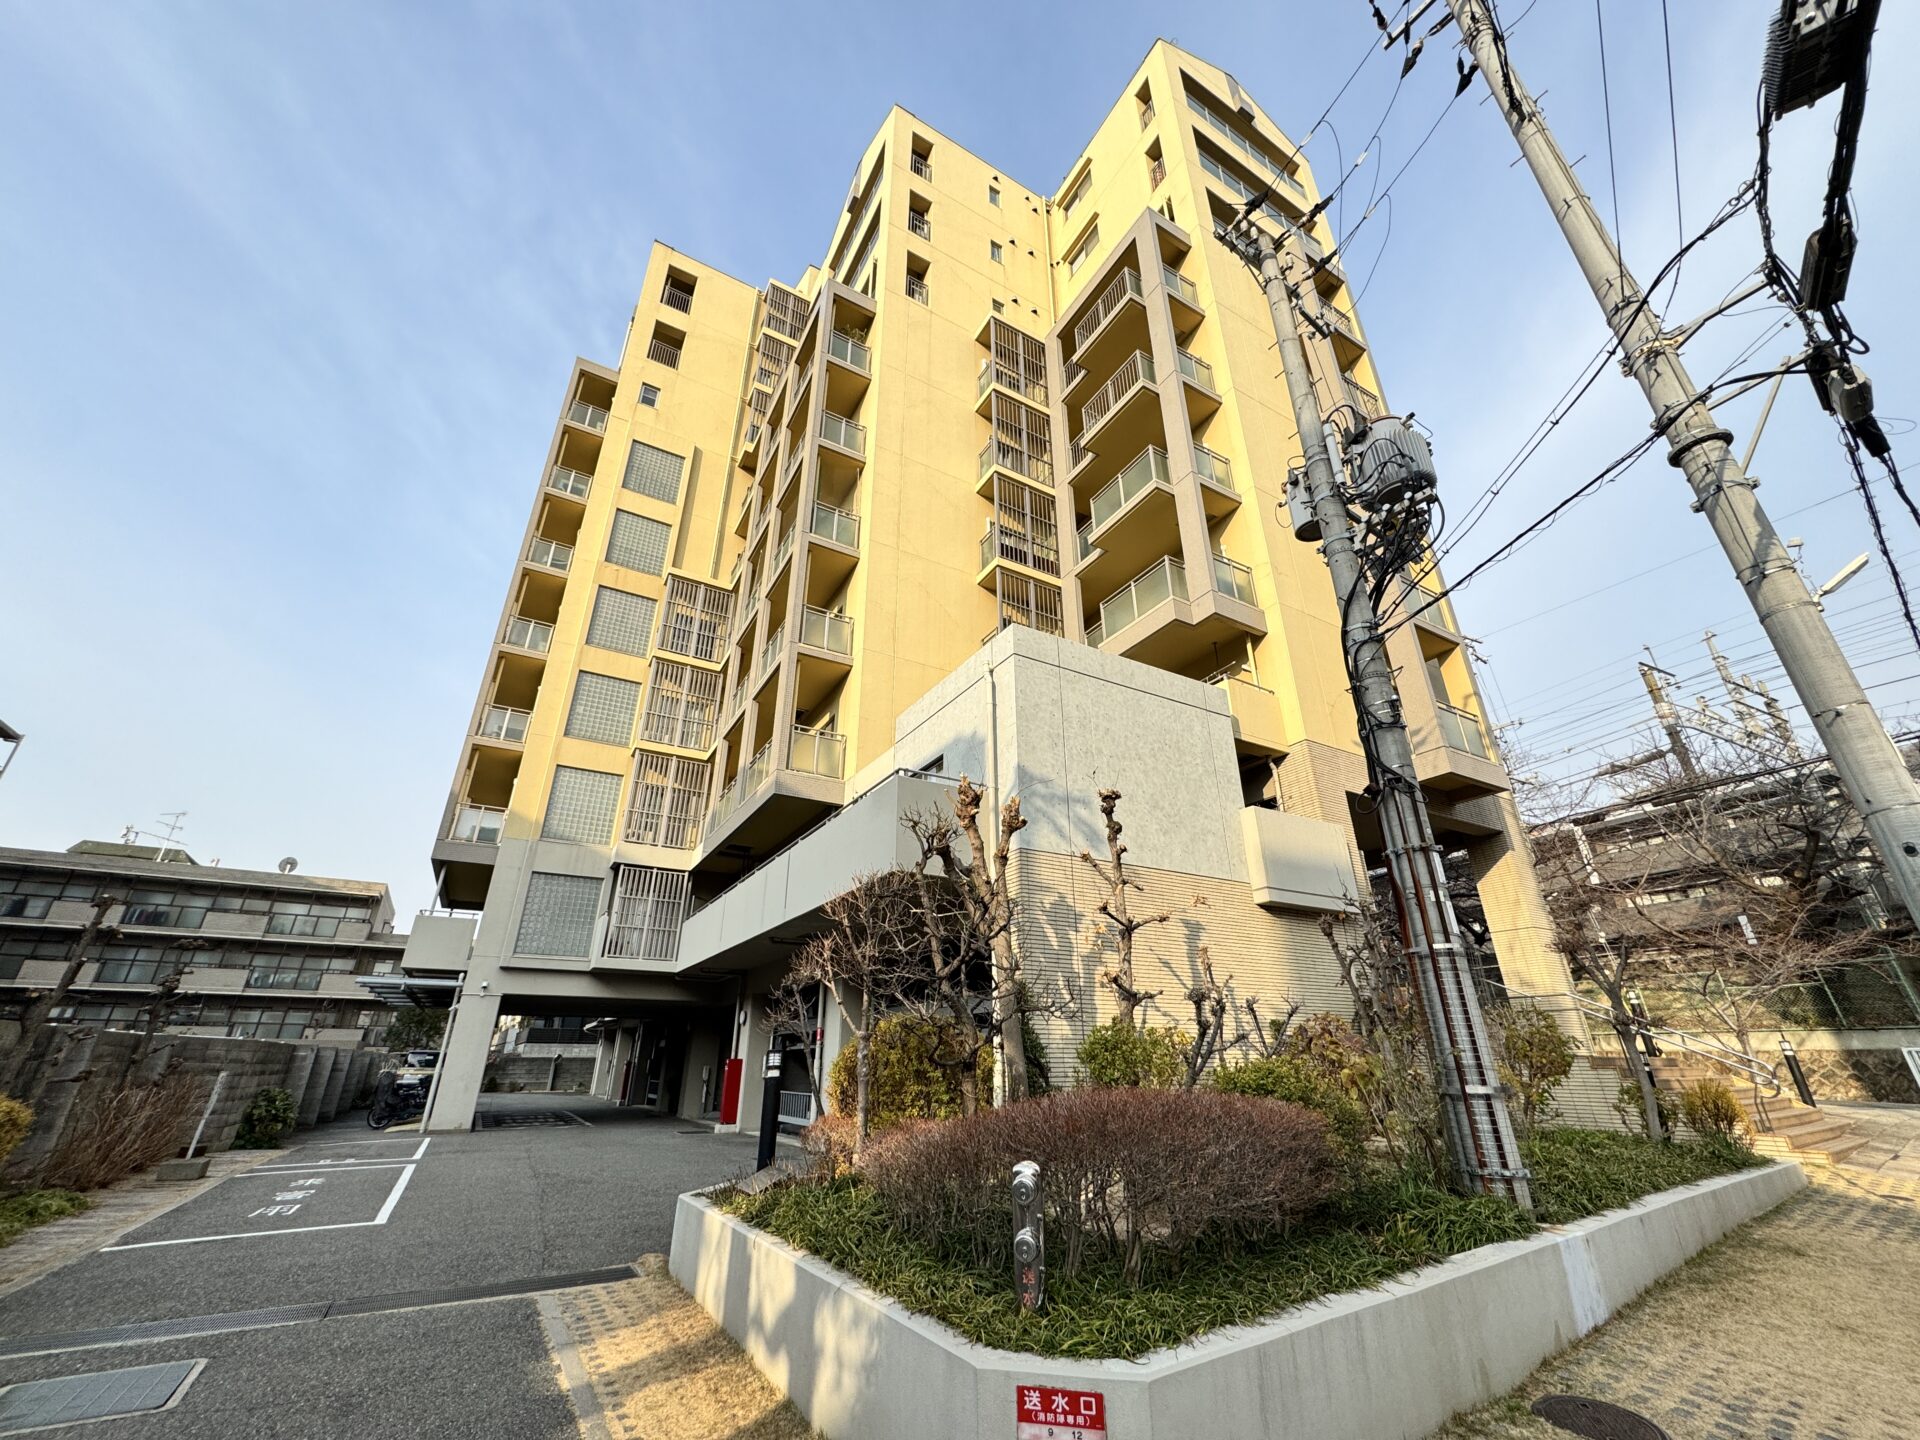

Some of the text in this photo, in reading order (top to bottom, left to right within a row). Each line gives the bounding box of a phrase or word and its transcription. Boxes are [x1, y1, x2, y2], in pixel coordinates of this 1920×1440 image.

[1024, 1389, 1096, 1415] 送水口
[1071, 1430, 1083, 1440] 12
